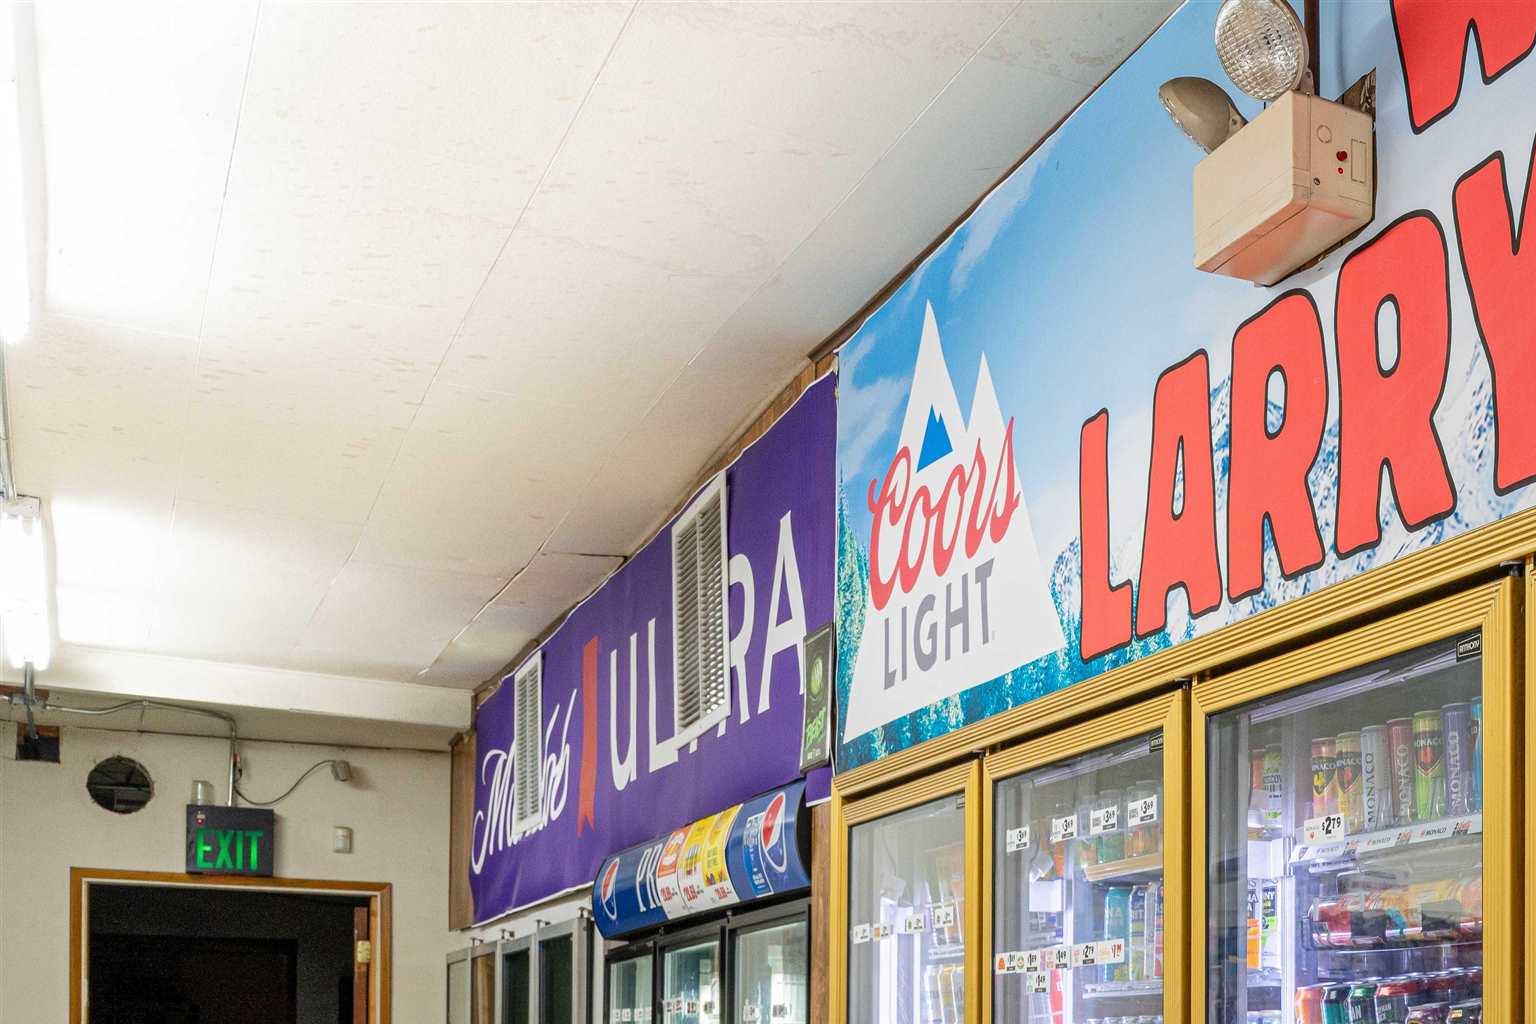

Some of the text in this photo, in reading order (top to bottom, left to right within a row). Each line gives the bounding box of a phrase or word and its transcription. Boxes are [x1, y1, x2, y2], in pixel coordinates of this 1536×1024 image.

[868, 415, 1021, 609] Coors
[609, 510, 807, 790] ULRA
[883, 557, 995, 690] LIGHT
[1460, 639, 1480, 654] ANTHONY
[1140, 799, 1154, 814] $369
[1367, 753, 1376, 824] MONACO
[1399, 744, 1408, 819] MONACO
[1448, 731, 1460, 817] MONACO
[196, 829, 262, 870] EXIT
[1103, 809, 1116, 823] $369
[1321, 816, 1342, 836] $279
